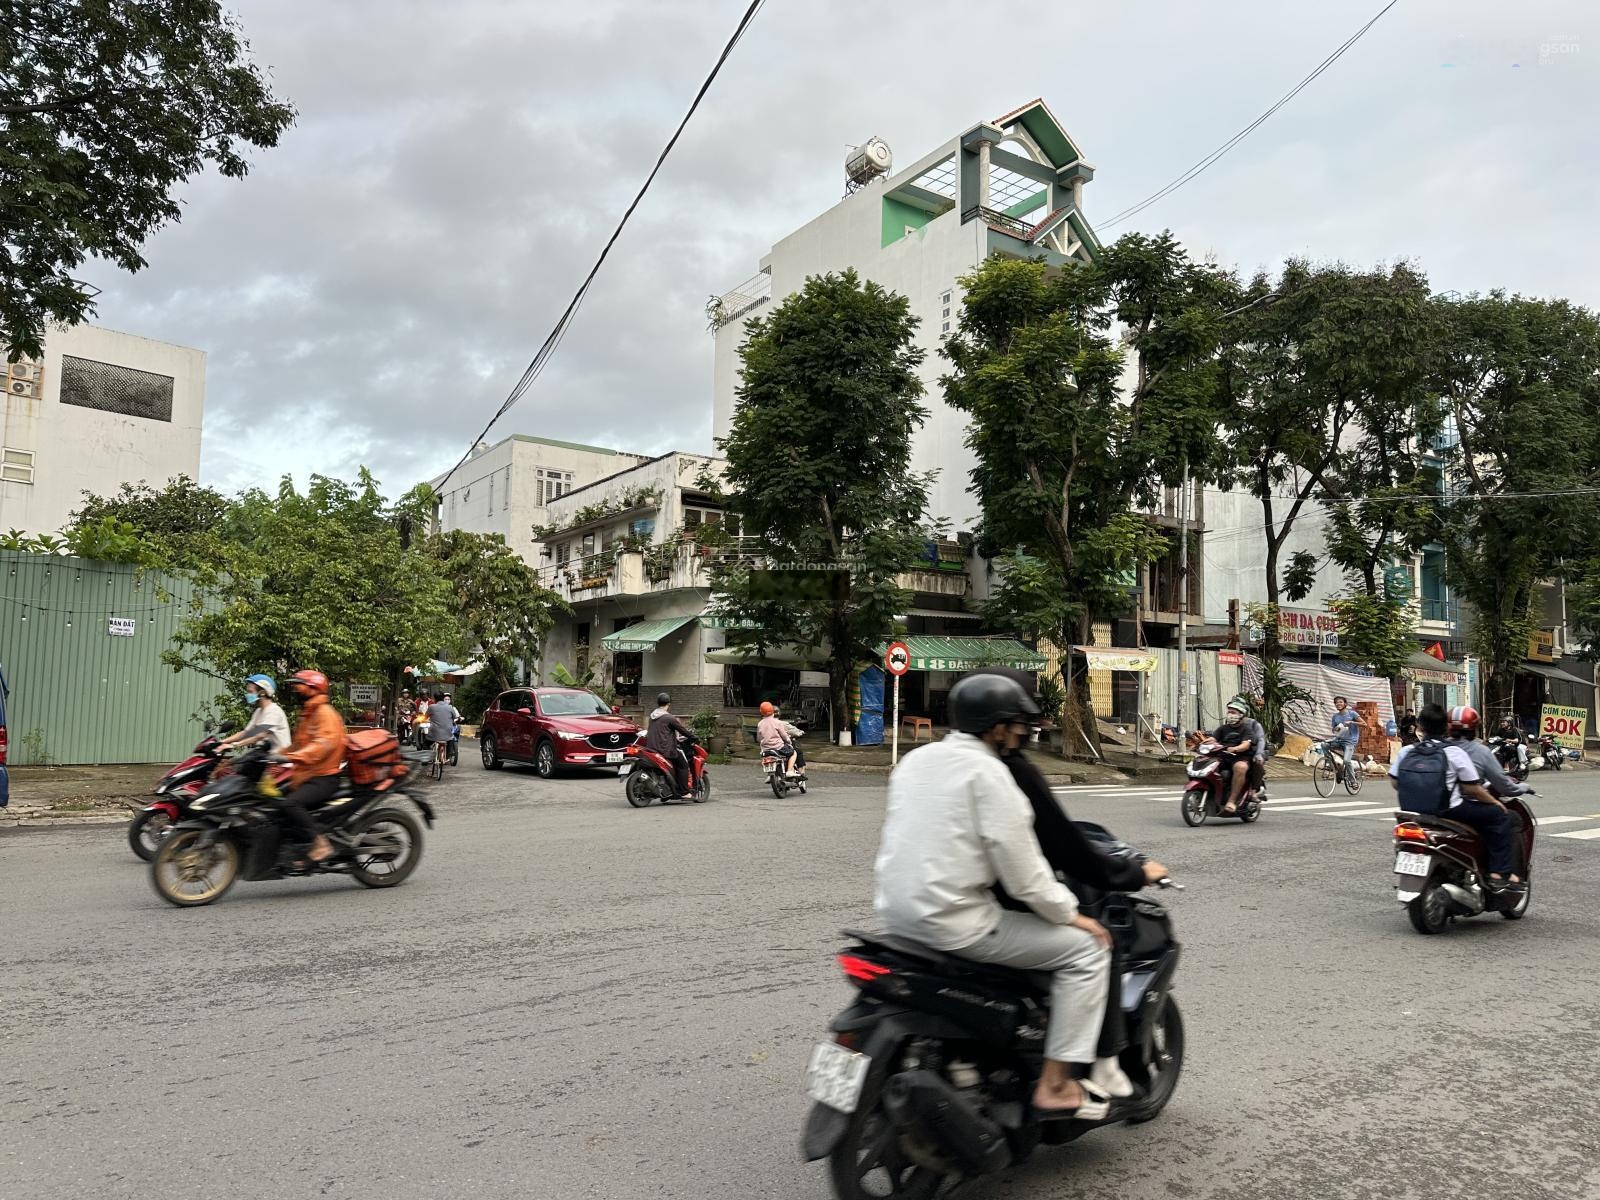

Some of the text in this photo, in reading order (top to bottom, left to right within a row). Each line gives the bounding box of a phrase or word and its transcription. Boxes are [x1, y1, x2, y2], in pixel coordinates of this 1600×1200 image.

[916, 659, 945, 669] 18
[1542, 706, 1559, 716] CƠM
[1543, 716, 1582, 736] 30K
